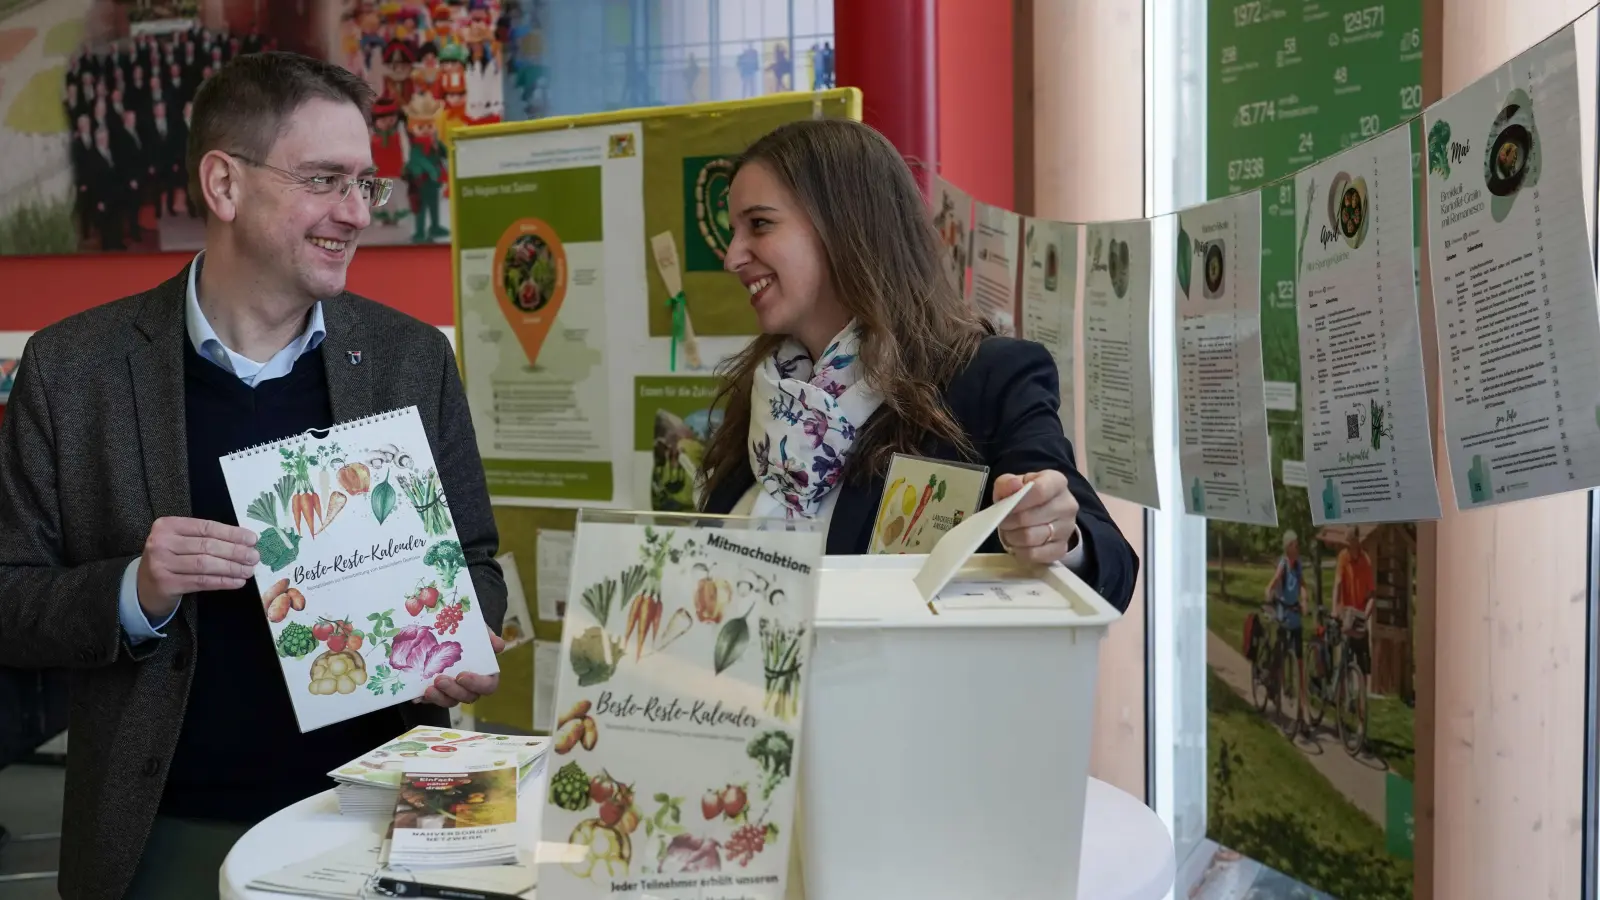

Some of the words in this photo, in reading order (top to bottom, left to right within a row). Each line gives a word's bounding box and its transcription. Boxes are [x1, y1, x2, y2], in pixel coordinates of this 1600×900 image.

[294, 534, 427, 585] Beste-Reste-Kalender
[707, 533, 811, 575] Mitmachaktion:
[596, 690, 760, 728] Beste-Reste-Kalender
[611, 881, 638, 893] Jeder
[641, 879, 698, 891] Teilnehmer
